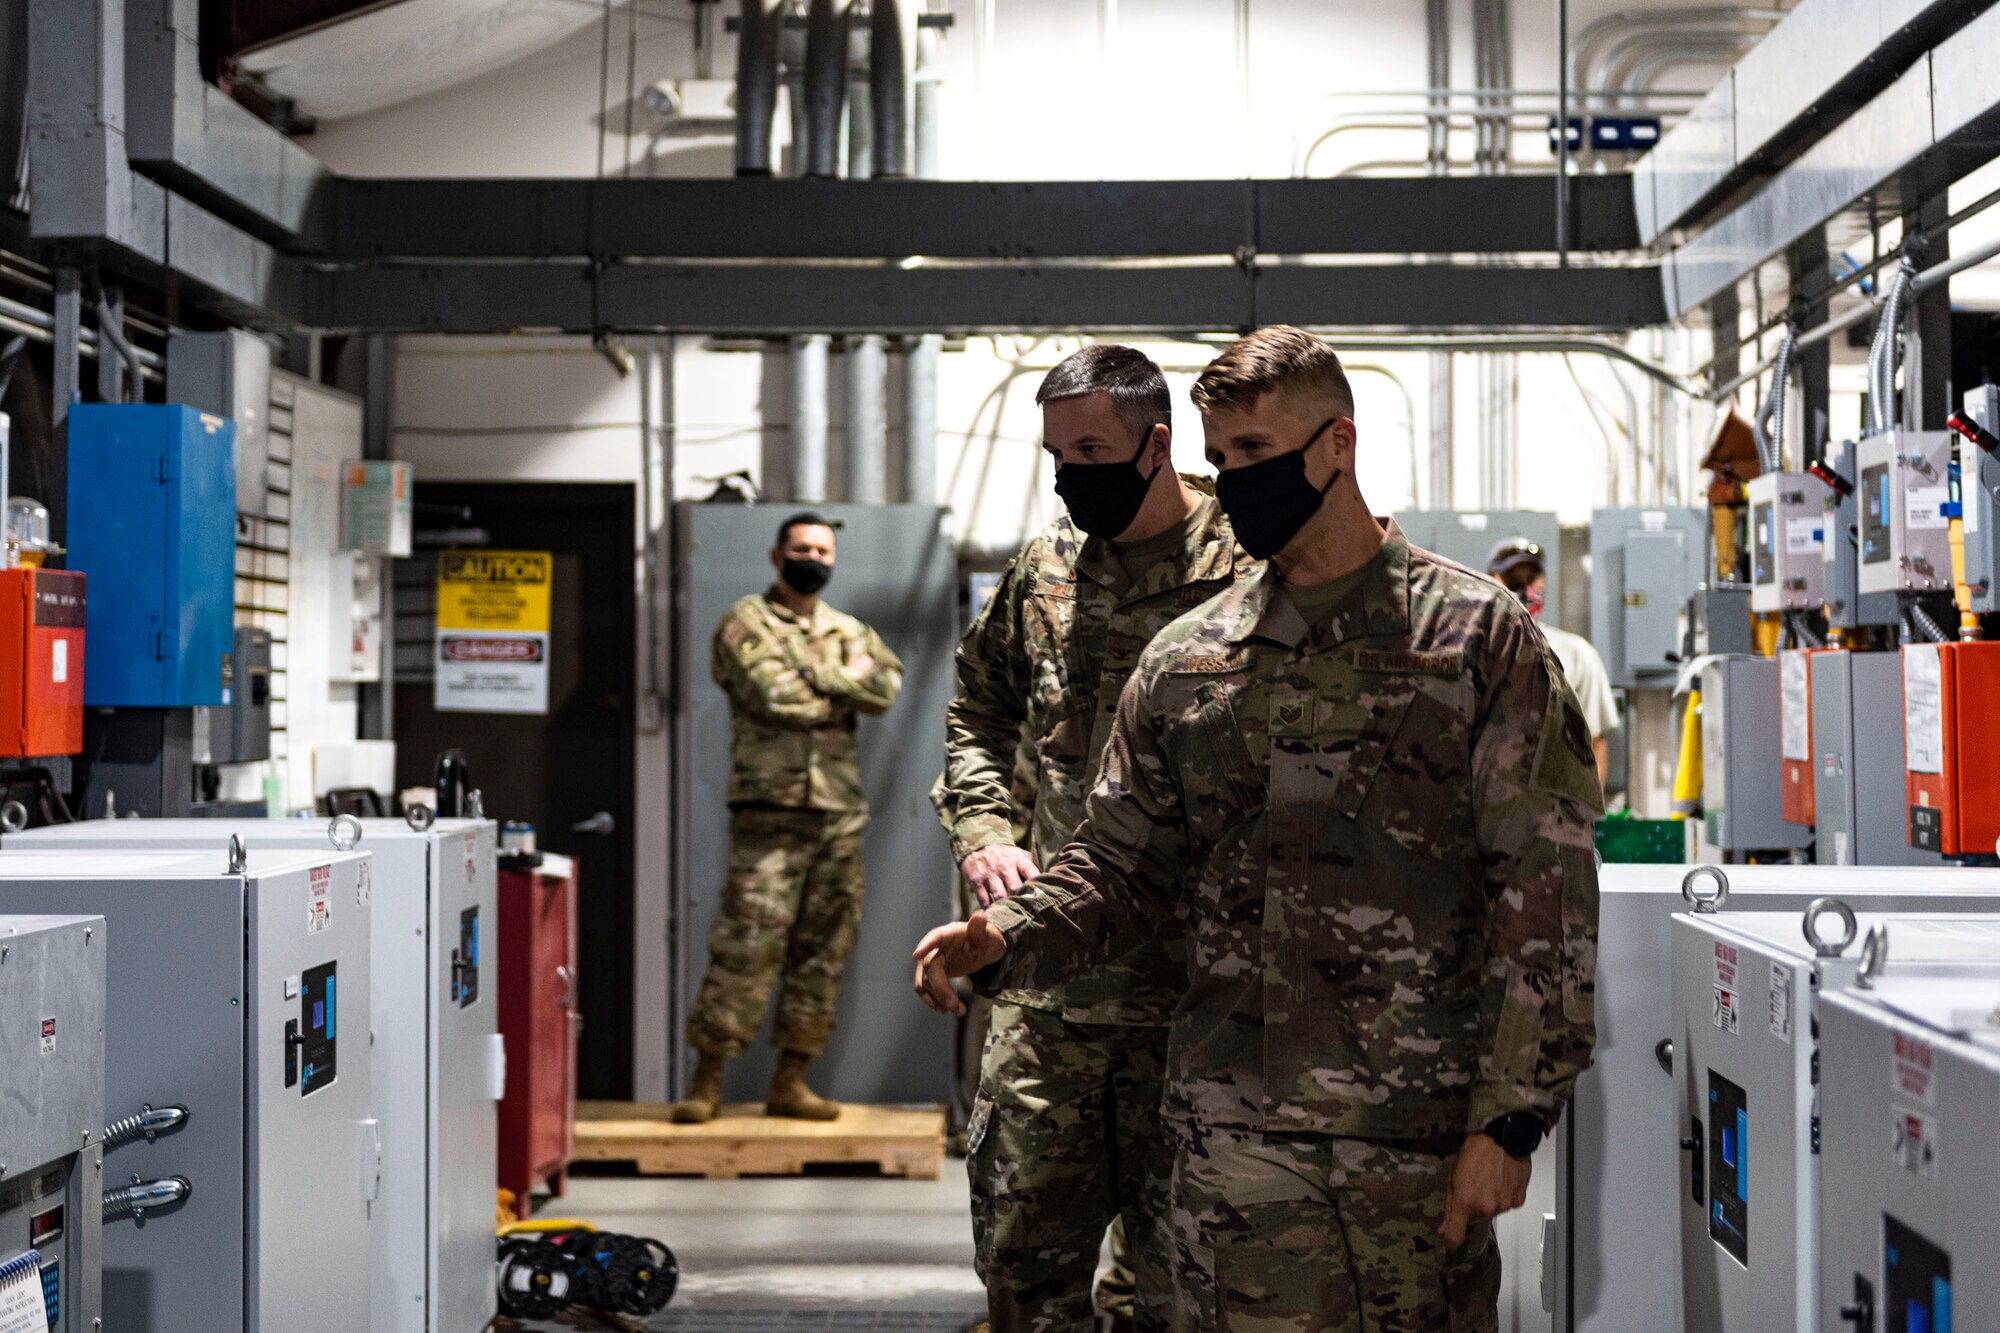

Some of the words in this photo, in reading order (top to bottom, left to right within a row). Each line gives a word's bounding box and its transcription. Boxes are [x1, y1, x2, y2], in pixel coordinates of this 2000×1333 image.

[448, 556, 546, 579] CAUTION
[454, 641, 531, 659] DANGER
[1384, 653, 1407, 670] AIR
[1413, 653, 1457, 673] FORCE
